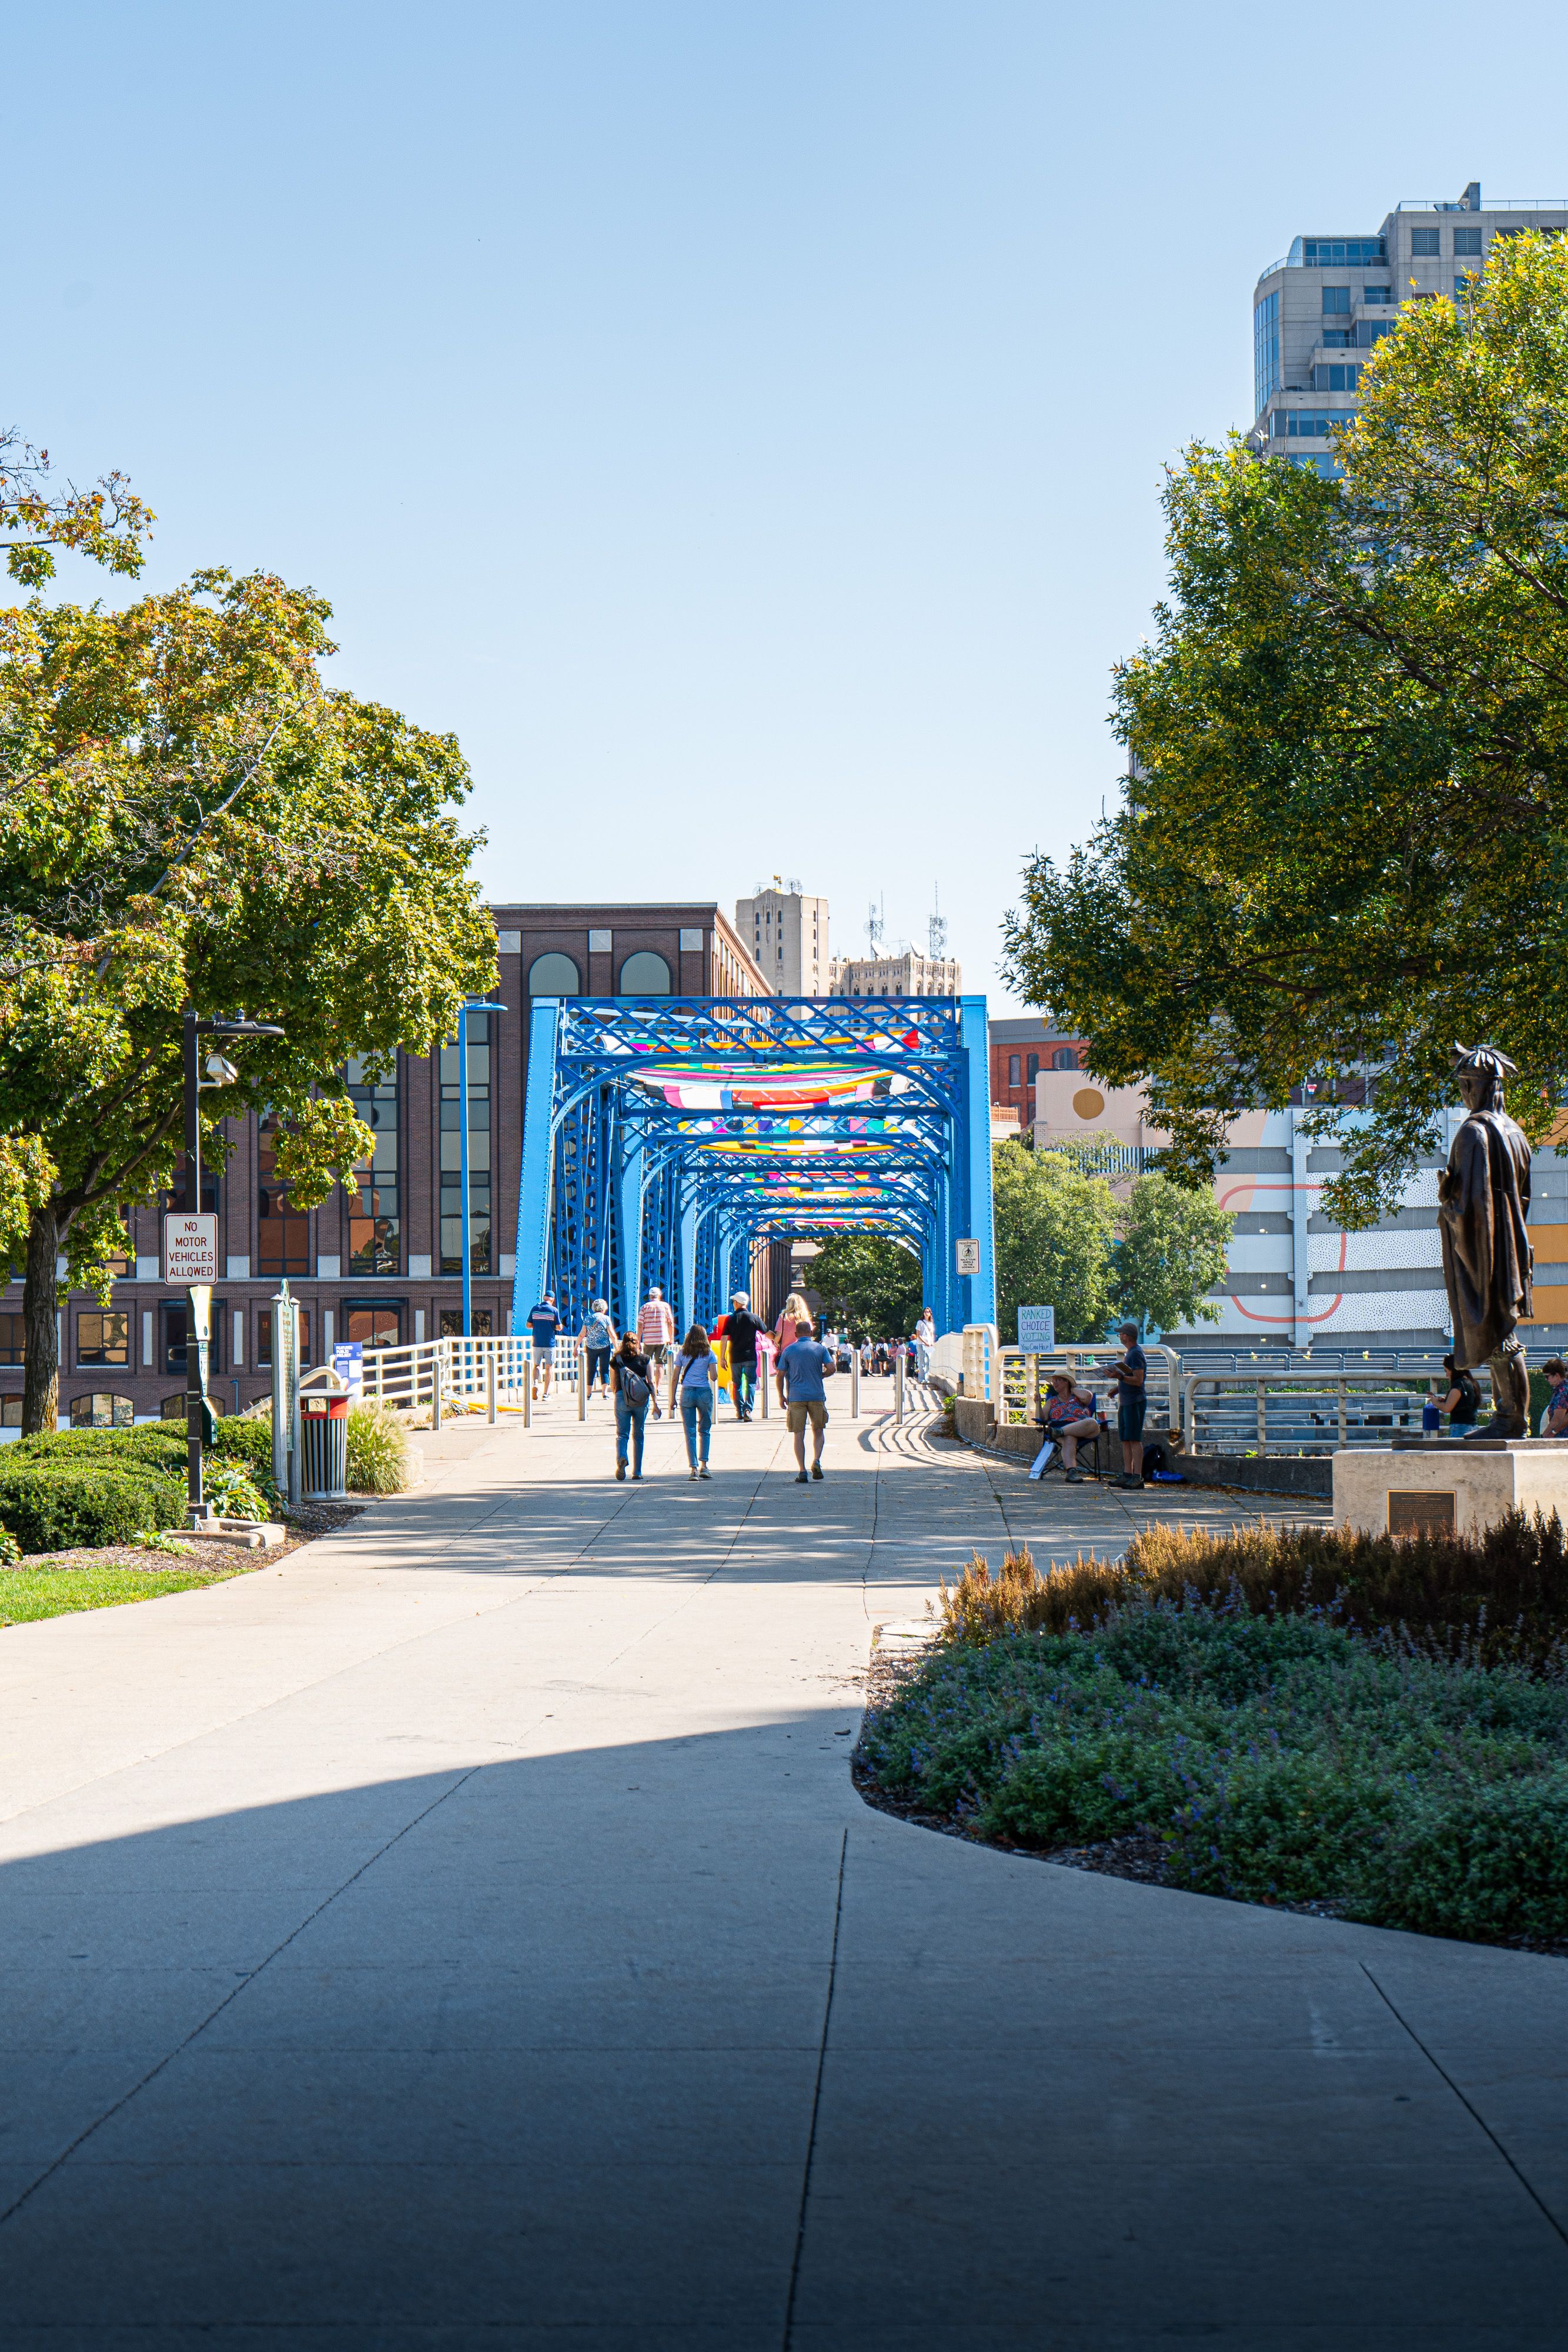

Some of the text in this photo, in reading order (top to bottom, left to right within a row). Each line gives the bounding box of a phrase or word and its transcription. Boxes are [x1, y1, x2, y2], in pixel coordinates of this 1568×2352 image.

[185, 1222, 197, 1232] NO
[175, 1237, 206, 1247] MOTOR
[169, 1252, 213, 1261] VEHICLES
[169, 1266, 213, 1277] ALLOWED
[1021, 1309, 1051, 1319] RANKED
[1021, 1321, 1050, 1331] CHOICE
[1021, 1332, 1050, 1340] VOTING
